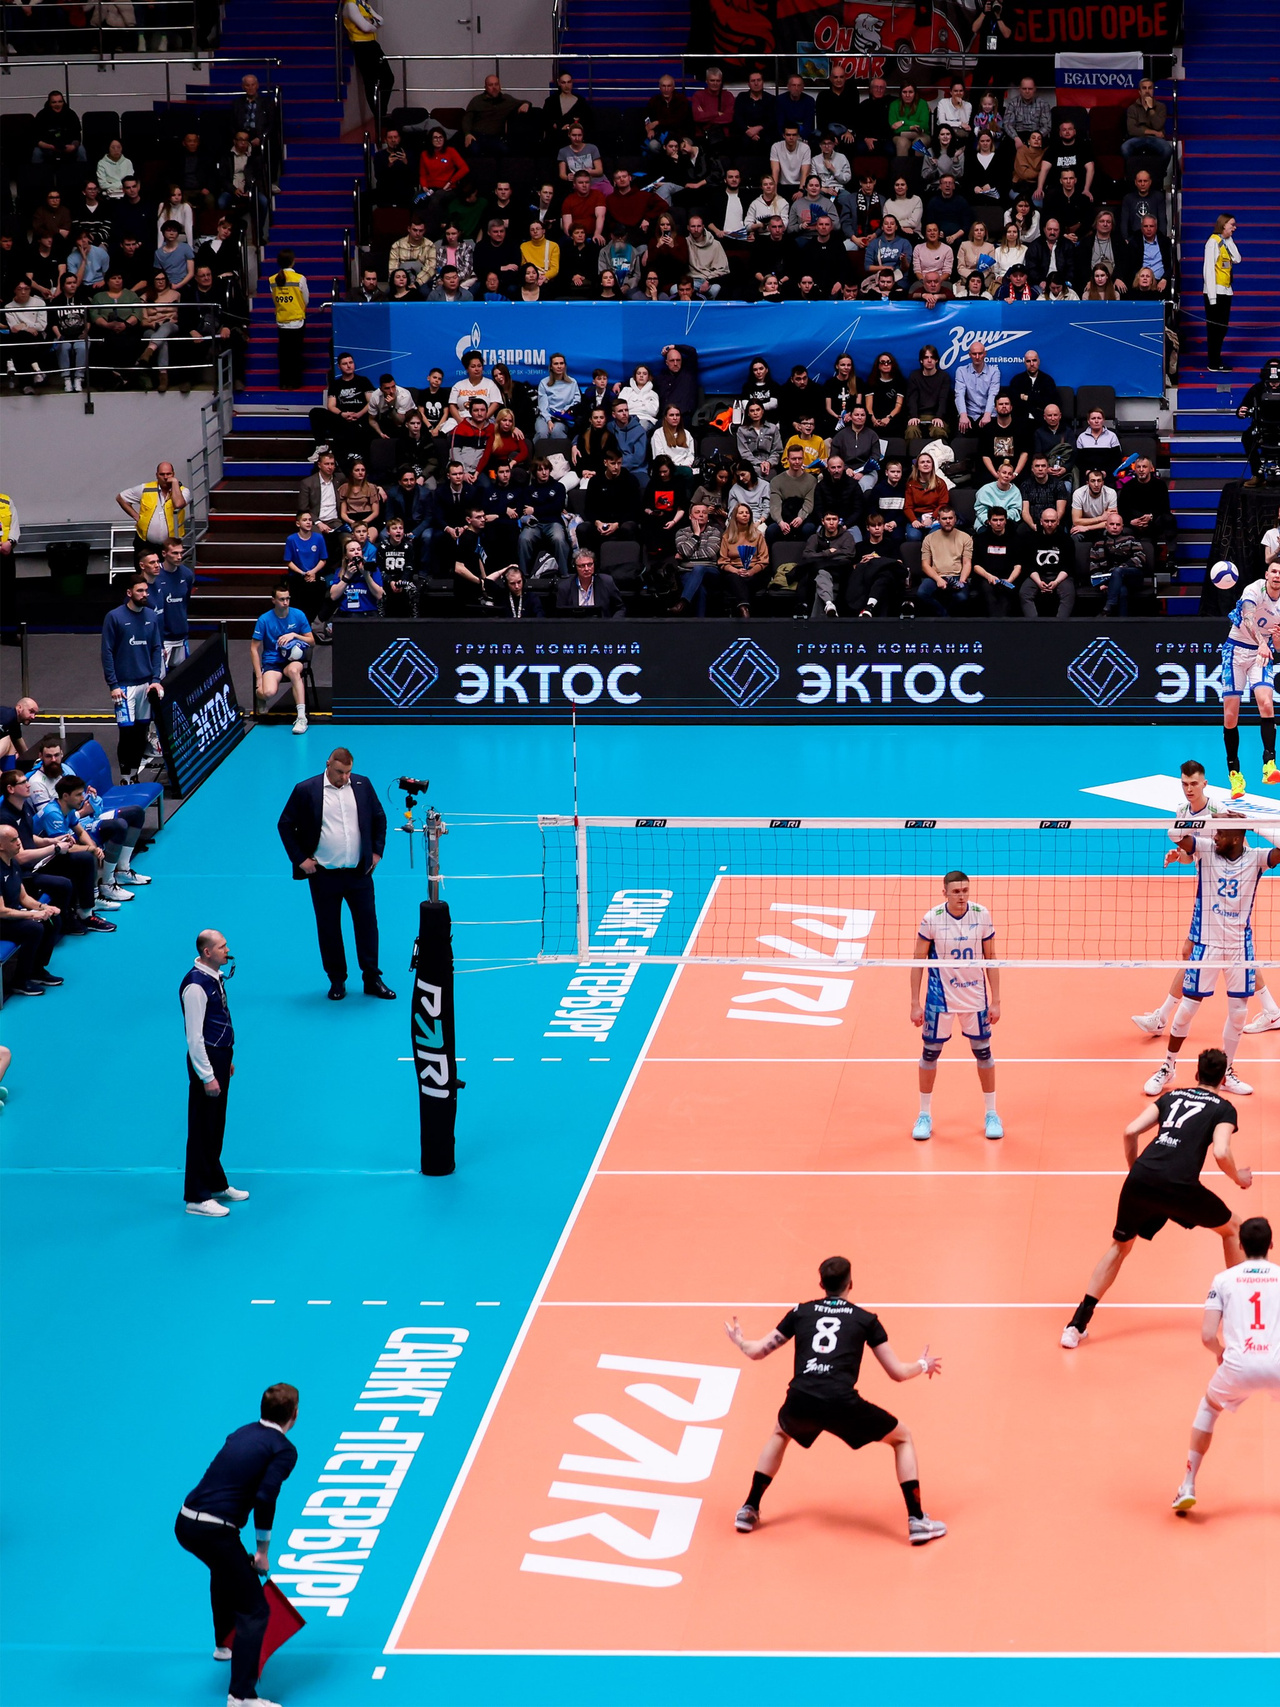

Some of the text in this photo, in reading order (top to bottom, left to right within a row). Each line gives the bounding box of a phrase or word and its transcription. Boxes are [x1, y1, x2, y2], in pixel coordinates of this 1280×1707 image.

[1014, 2, 1168, 42] БЕЛОГОРЬЕ
[1064, 72, 1134, 87] БЕЛГОРОД
[983, 355, 1026, 363] ОЛЕЙБОЛЬ
[1257, 617, 1268, 628] 0
[455, 642, 641, 654] ГРУППА КОМПАНИЙ
[797, 641, 983, 654] ГРУППА КОМПАНИЙ
[1155, 643, 1224, 653] ГРУППА
[454, 663, 642, 705] ЭКТОС
[796, 662, 985, 704] ЭКТОС
[192, 684, 236, 752] ЭКТОС
[637, 820, 665, 828] PARI
[771, 820, 799, 828] PARI
[906, 820, 934, 828] PARI
[1217, 878, 1239, 899] 23
[726, 903, 877, 1026] PARI
[415, 978, 450, 1098] PARI
[1162, 1098, 1206, 1129] 17
[814, 1304, 854, 1315] ТЕТЮХИН
[1249, 1291, 1265, 1330] 1
[811, 1316, 841, 1354] 8
[270, 1327, 470, 1617] САНКТ-ПЕТЕРБУРГ
[520, 1353, 741, 1588] PARI
